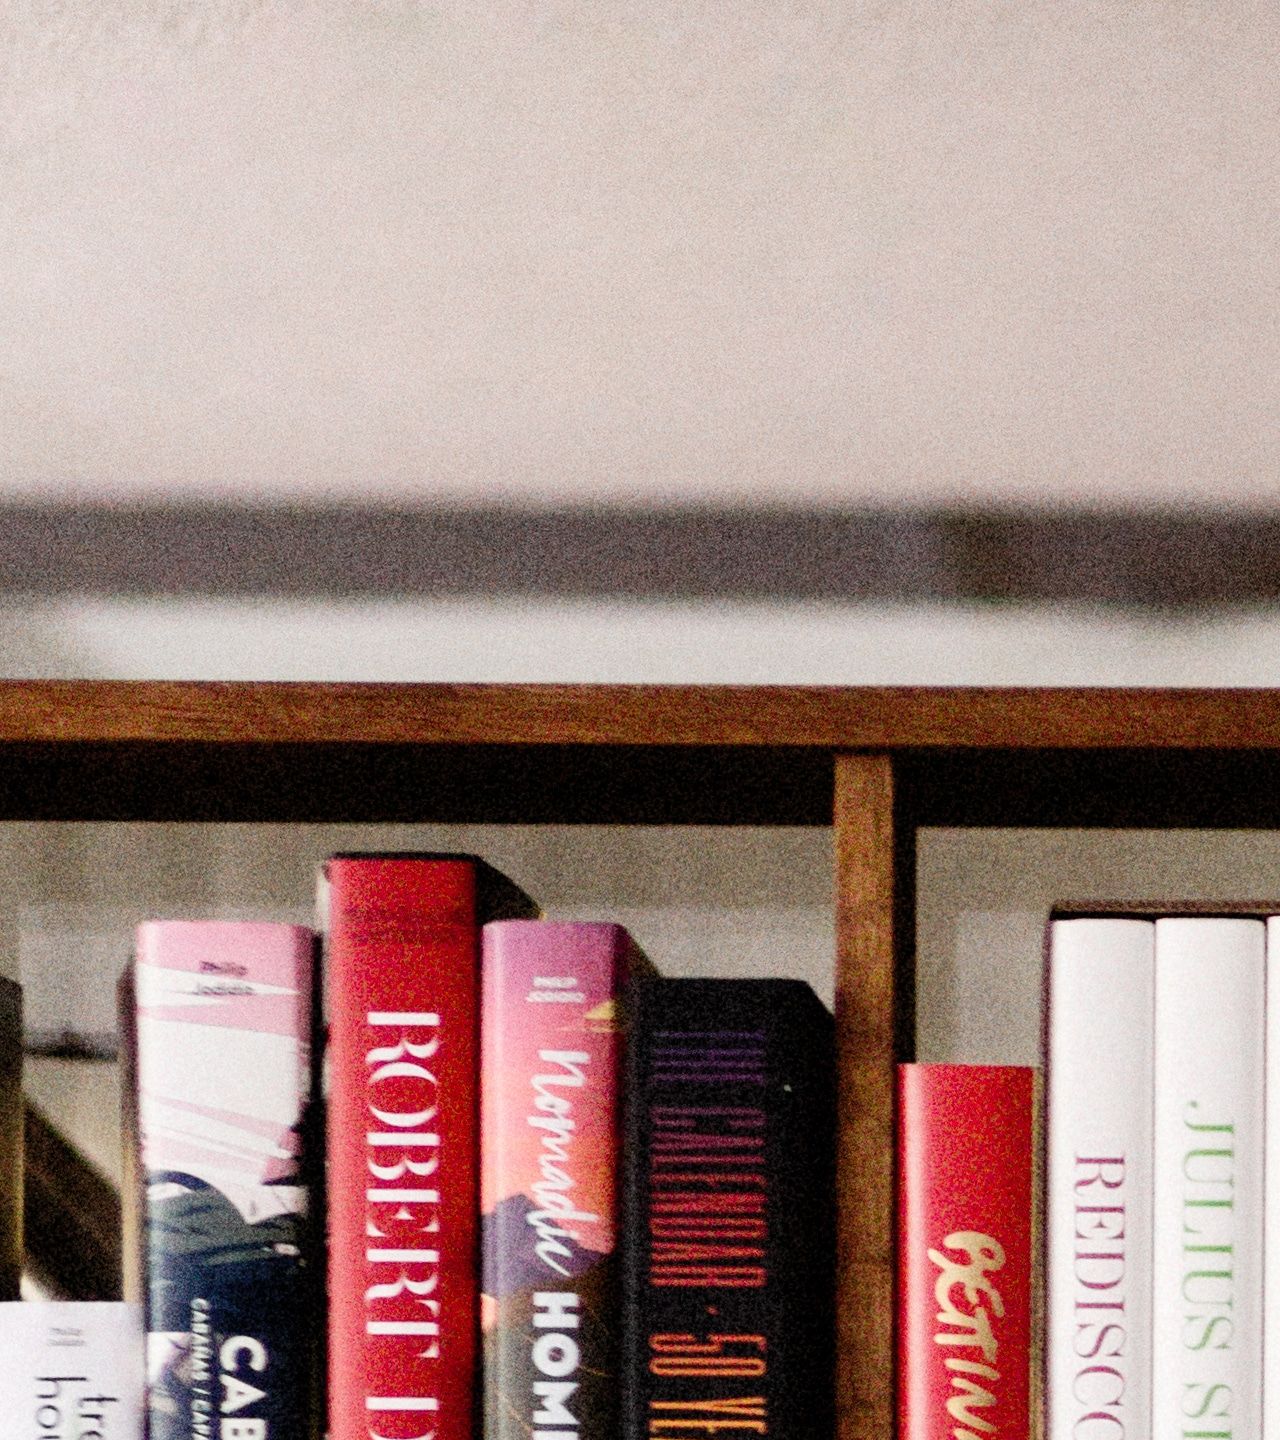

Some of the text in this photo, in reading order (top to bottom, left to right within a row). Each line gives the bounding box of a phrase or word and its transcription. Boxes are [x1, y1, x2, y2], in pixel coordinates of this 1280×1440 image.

[649, 1030, 767, 1085] THE
[365, 1011, 441, 1359] ROBERT
[649, 1106, 767, 1288] CALENDAR
[1182, 1101, 1236, 1353] JULIUS
[649, 1333, 767, 1378] 50
